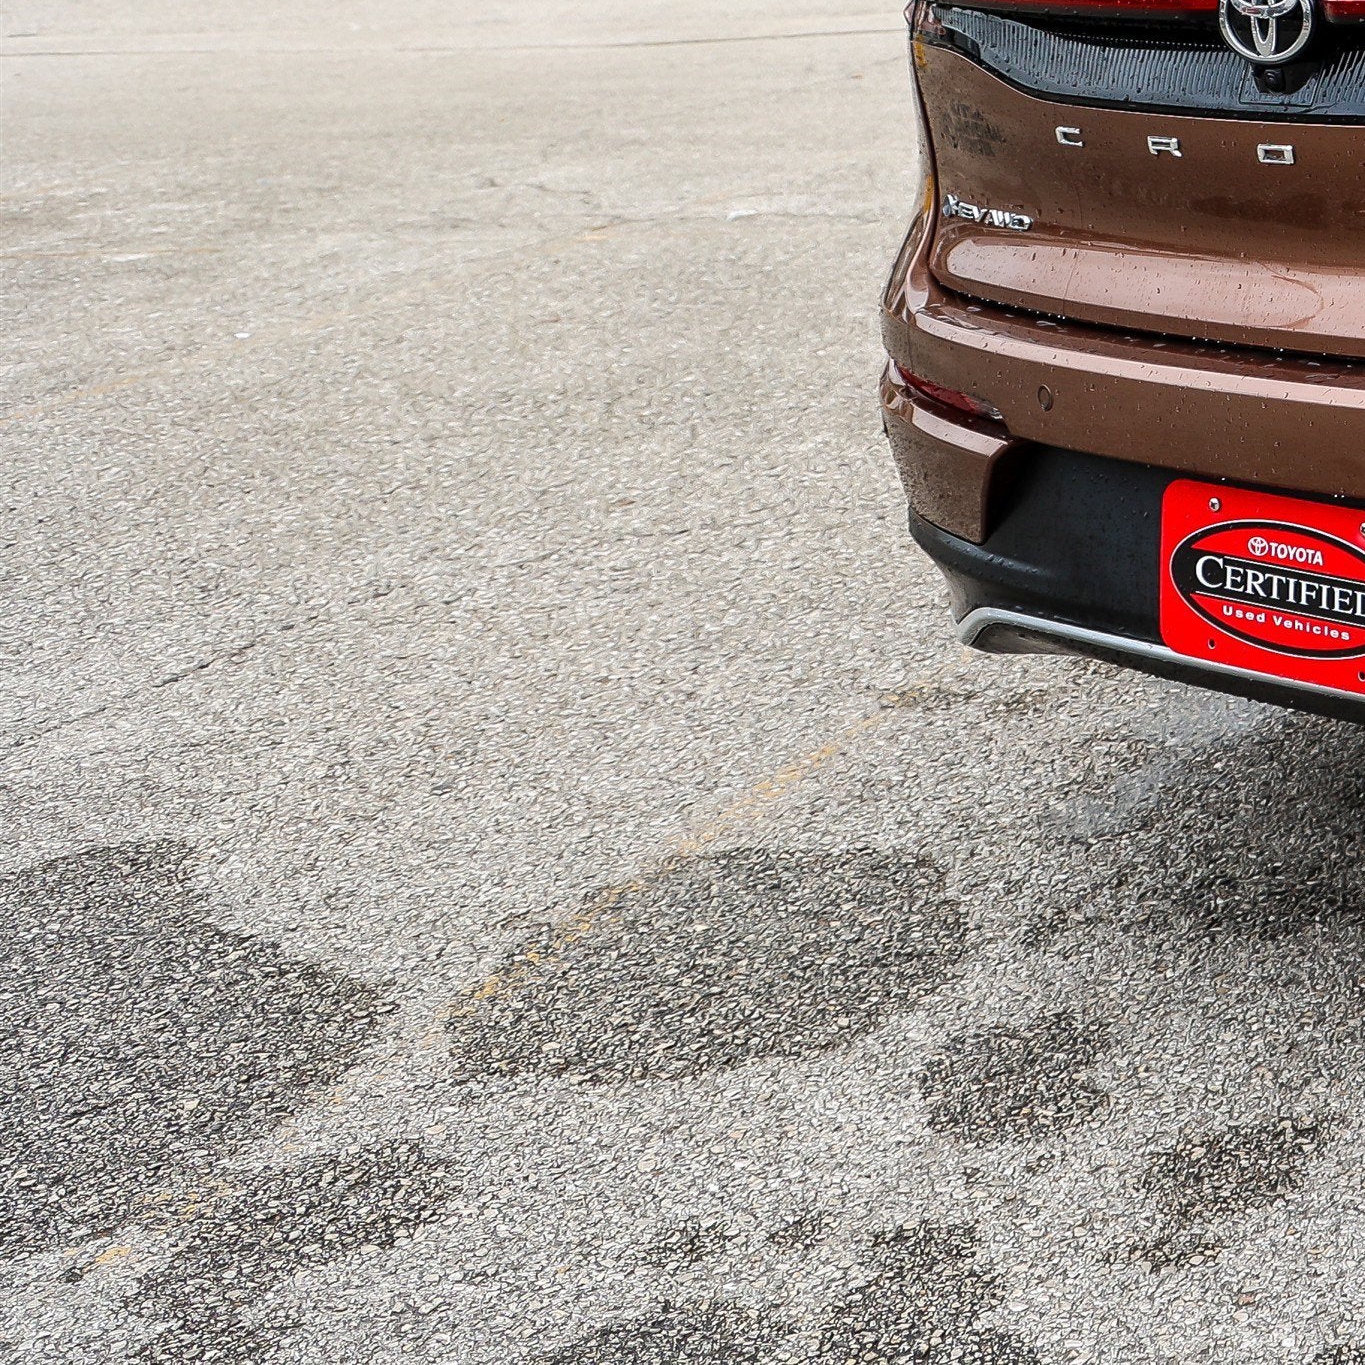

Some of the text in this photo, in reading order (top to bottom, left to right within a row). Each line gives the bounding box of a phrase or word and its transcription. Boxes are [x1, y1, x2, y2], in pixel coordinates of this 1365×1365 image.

[1269, 542, 1324, 566] TOYOTA
[1222, 605, 1350, 641] Used Vehicles
